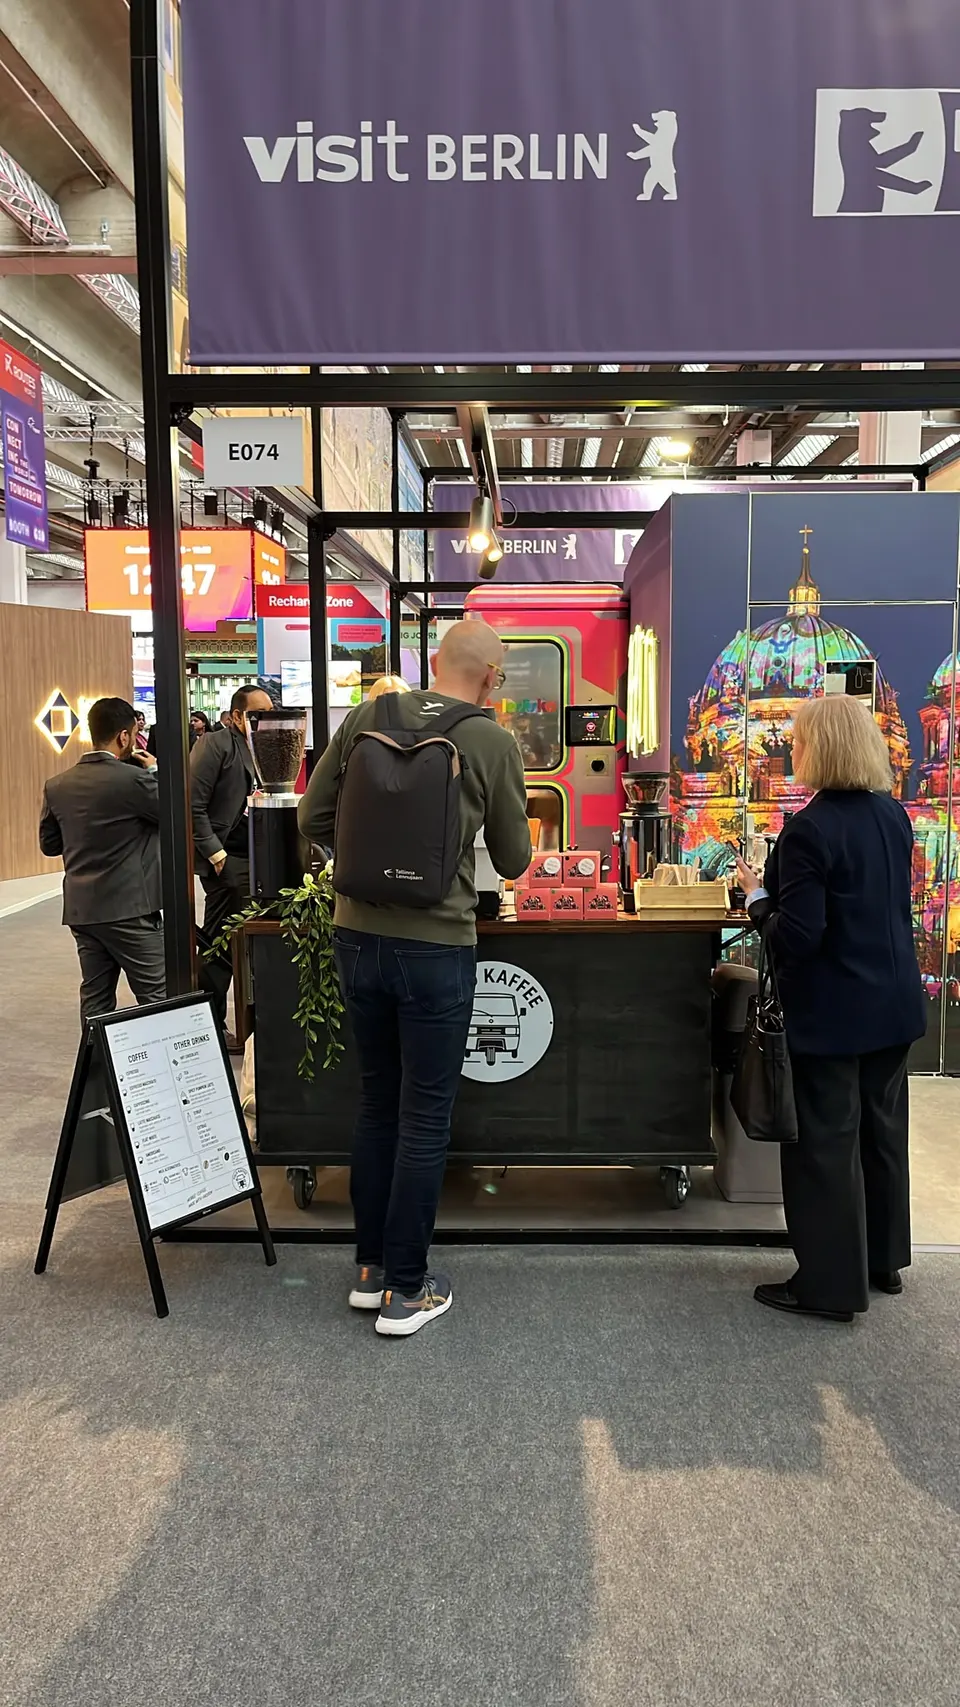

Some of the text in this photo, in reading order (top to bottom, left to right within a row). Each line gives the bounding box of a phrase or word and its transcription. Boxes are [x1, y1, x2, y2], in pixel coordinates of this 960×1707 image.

[243, 120, 608, 182] visit BERLIN
[229, 444, 279, 460] E074
[9, 481, 42, 505] TOMORROW
[8, 518, 30, 538] BOOTH
[504, 540, 557, 554] BERLIN
[326, 596, 354, 608] Zone
[484, 968, 544, 1008] KAFFEE
[174, 1040, 191, 1050] OTHER
[192, 1034, 210, 1046] DRINKS
[128, 1051, 148, 1063] COFFEE
